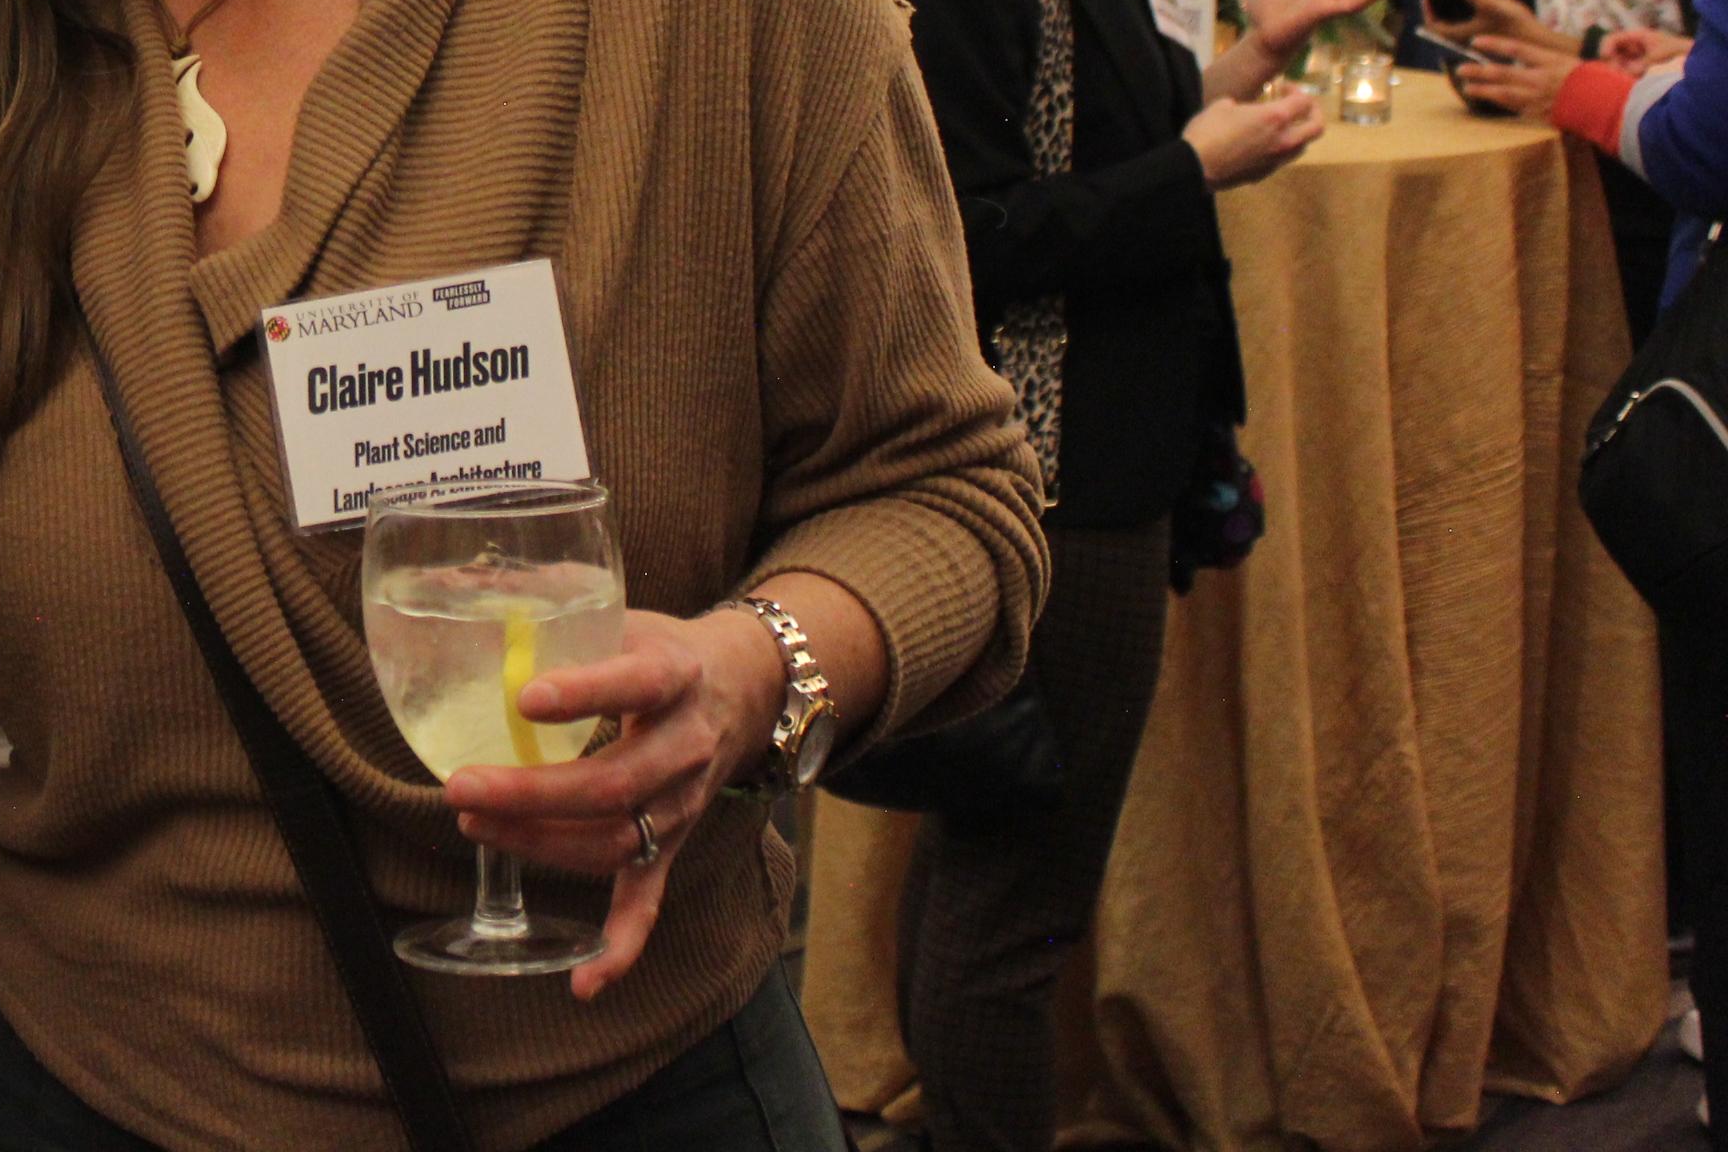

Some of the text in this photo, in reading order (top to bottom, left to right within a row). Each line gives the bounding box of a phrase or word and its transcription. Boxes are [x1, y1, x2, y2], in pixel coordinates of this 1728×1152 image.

[296, 291, 419, 321] UNIVERSITY OF
[435, 282, 482, 301] FEARLESSLY
[449, 292, 488, 308] FORWARD
[297, 301, 423, 338] MARYLAND
[307, 342, 529, 415] Claire Hudson
[355, 417, 506, 468] Plant Science and
[430, 460, 541, 483] Ahitecture
